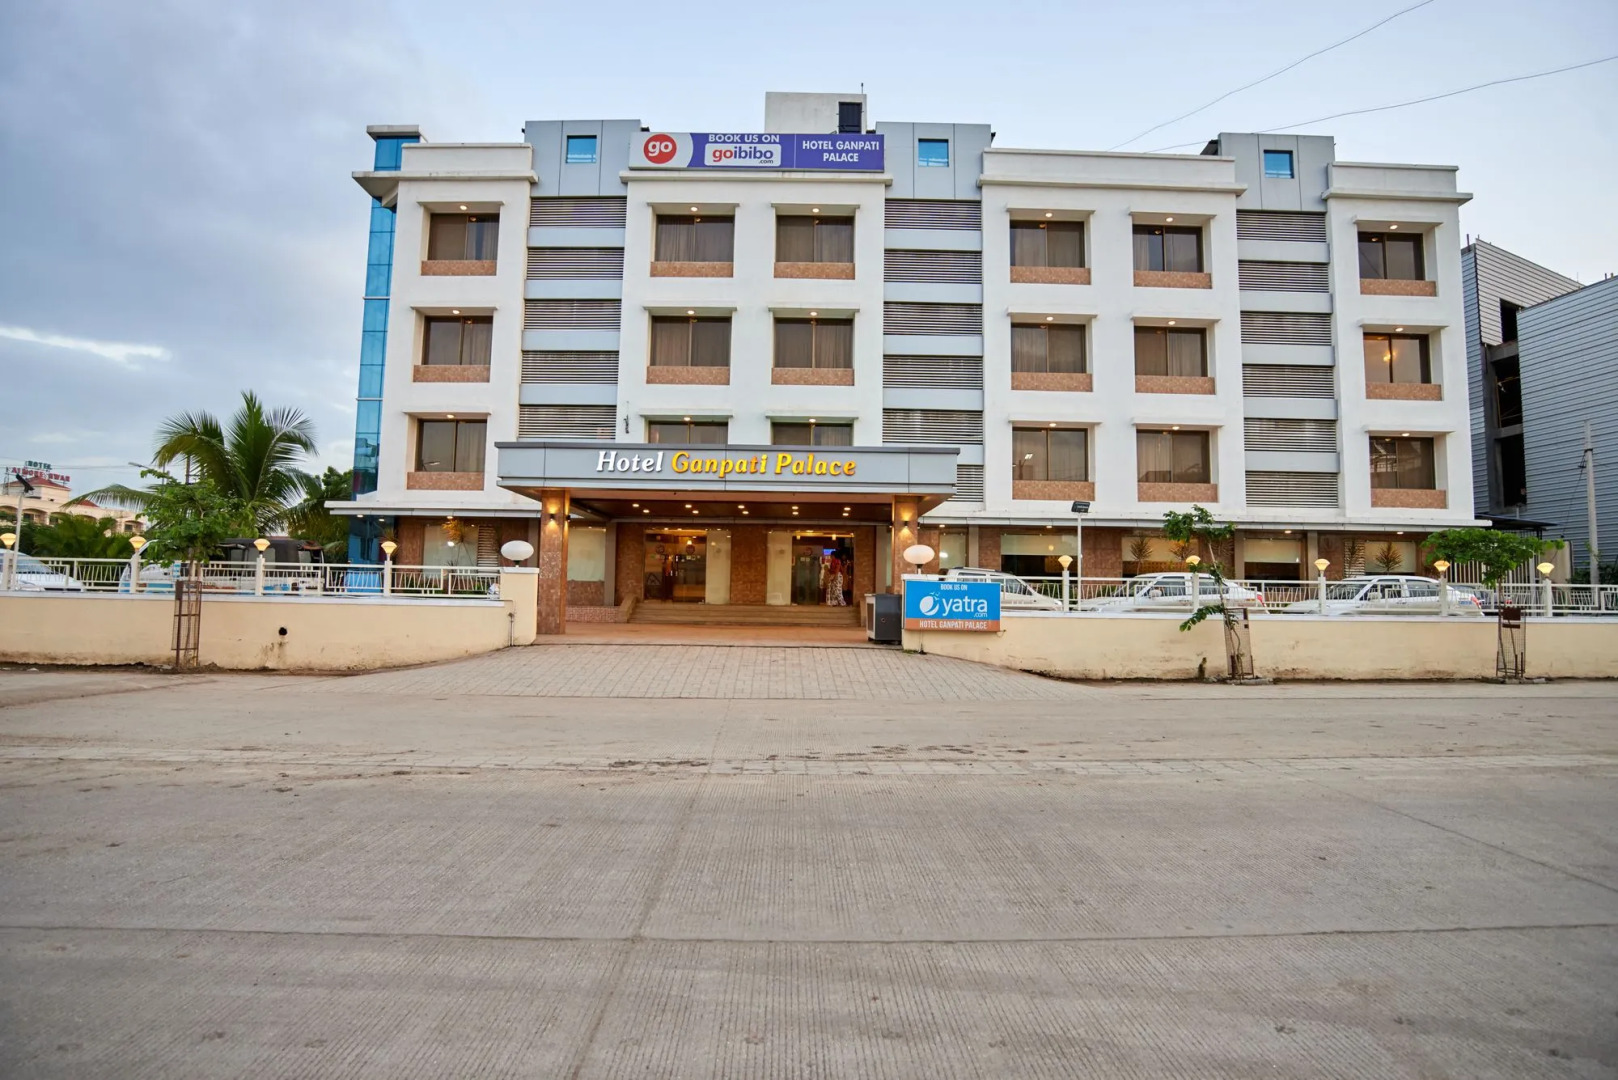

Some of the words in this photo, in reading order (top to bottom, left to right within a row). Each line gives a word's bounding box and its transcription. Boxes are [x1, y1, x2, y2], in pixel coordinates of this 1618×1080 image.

[708, 134, 741, 142] BOOK
[744, 134, 758, 143] US
[762, 134, 779, 143] ON
[648, 141, 672, 156] go
[802, 140, 833, 150] HOTEL
[836, 141, 879, 150] GANPATI
[712, 146, 773, 162] goibibo
[823, 153, 859, 162] PALACE
[596, 451, 664, 473] Hotel
[671, 451, 768, 478] Ganpati
[775, 453, 856, 476] Palace
[940, 583, 953, 591] BOOK
[942, 596, 988, 617] yatra
[919, 620, 938, 628] HOTEL
[939, 620, 964, 628] GANPATI
[965, 621, 987, 629] PALACE
